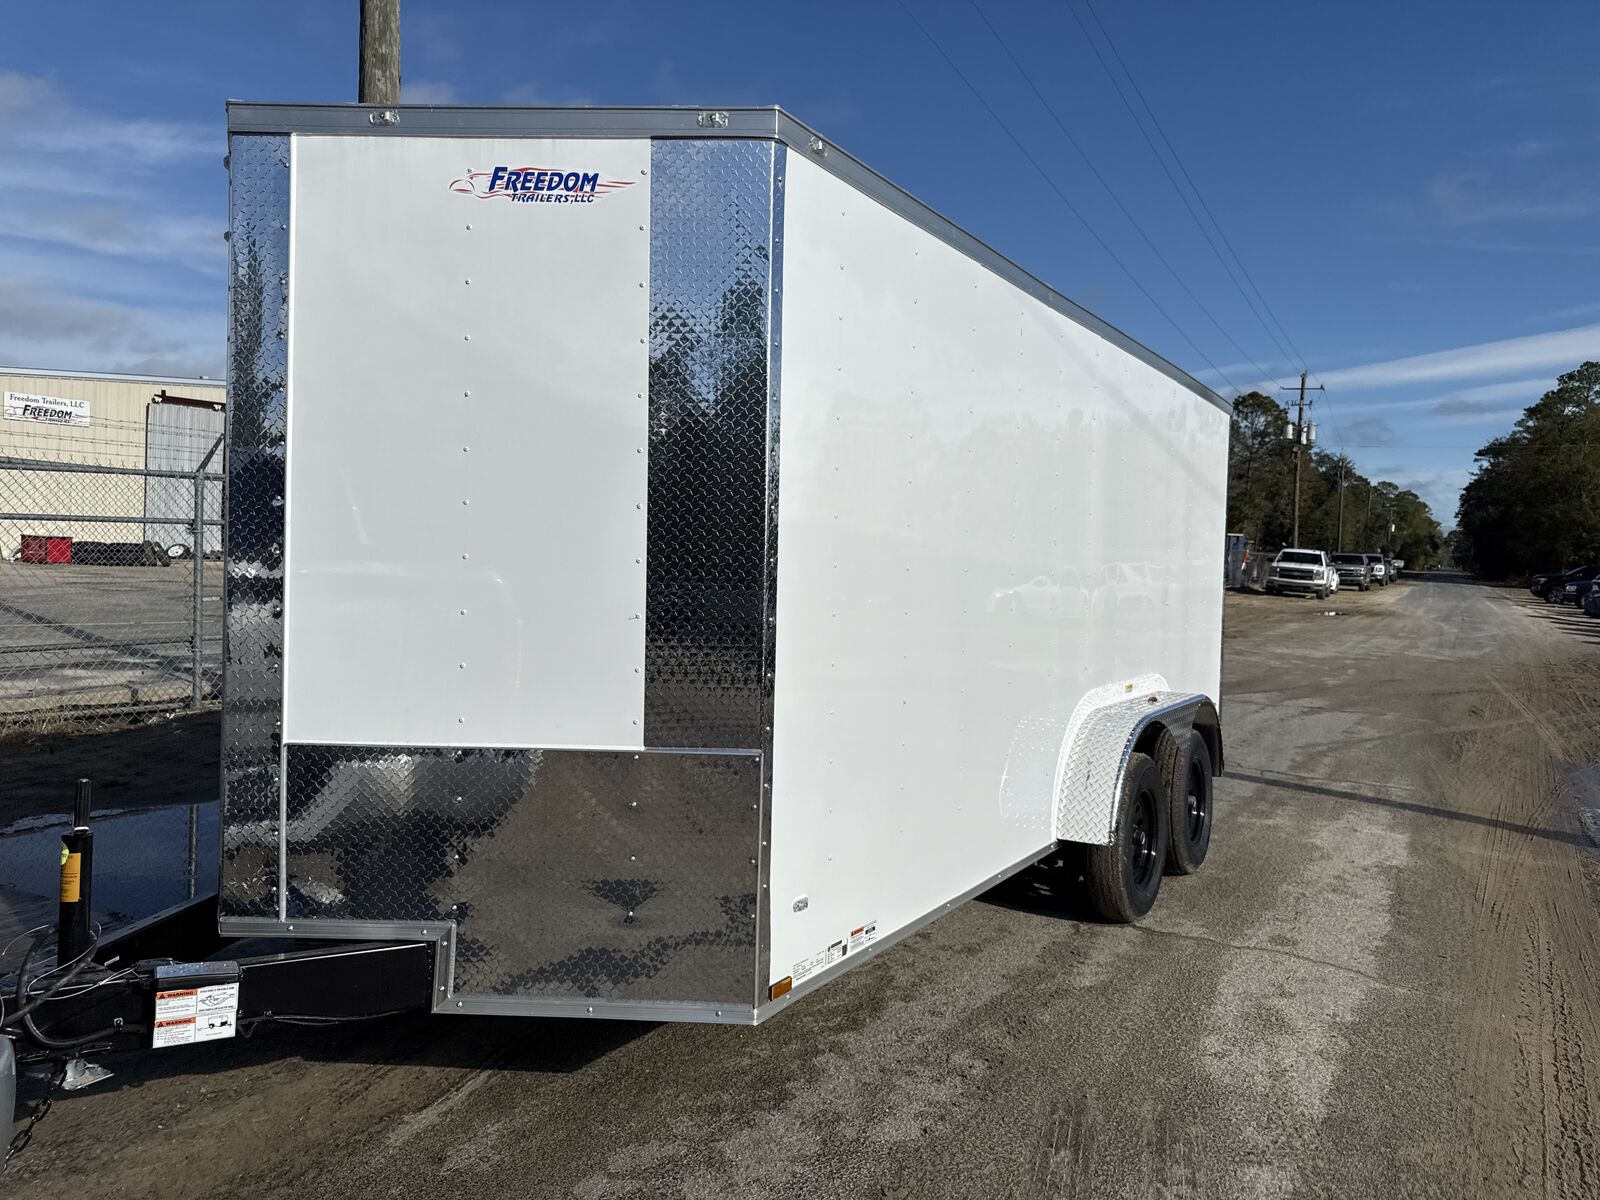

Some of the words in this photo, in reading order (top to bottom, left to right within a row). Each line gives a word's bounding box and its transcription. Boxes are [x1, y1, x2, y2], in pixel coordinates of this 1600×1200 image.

[488, 166, 599, 193] FREEDOM
[9, 393, 40, 404] Freedom
[41, 397, 69, 408] Trailers,
[70, 400, 85, 408] LLC
[22, 404, 73, 419] FREEDOM
